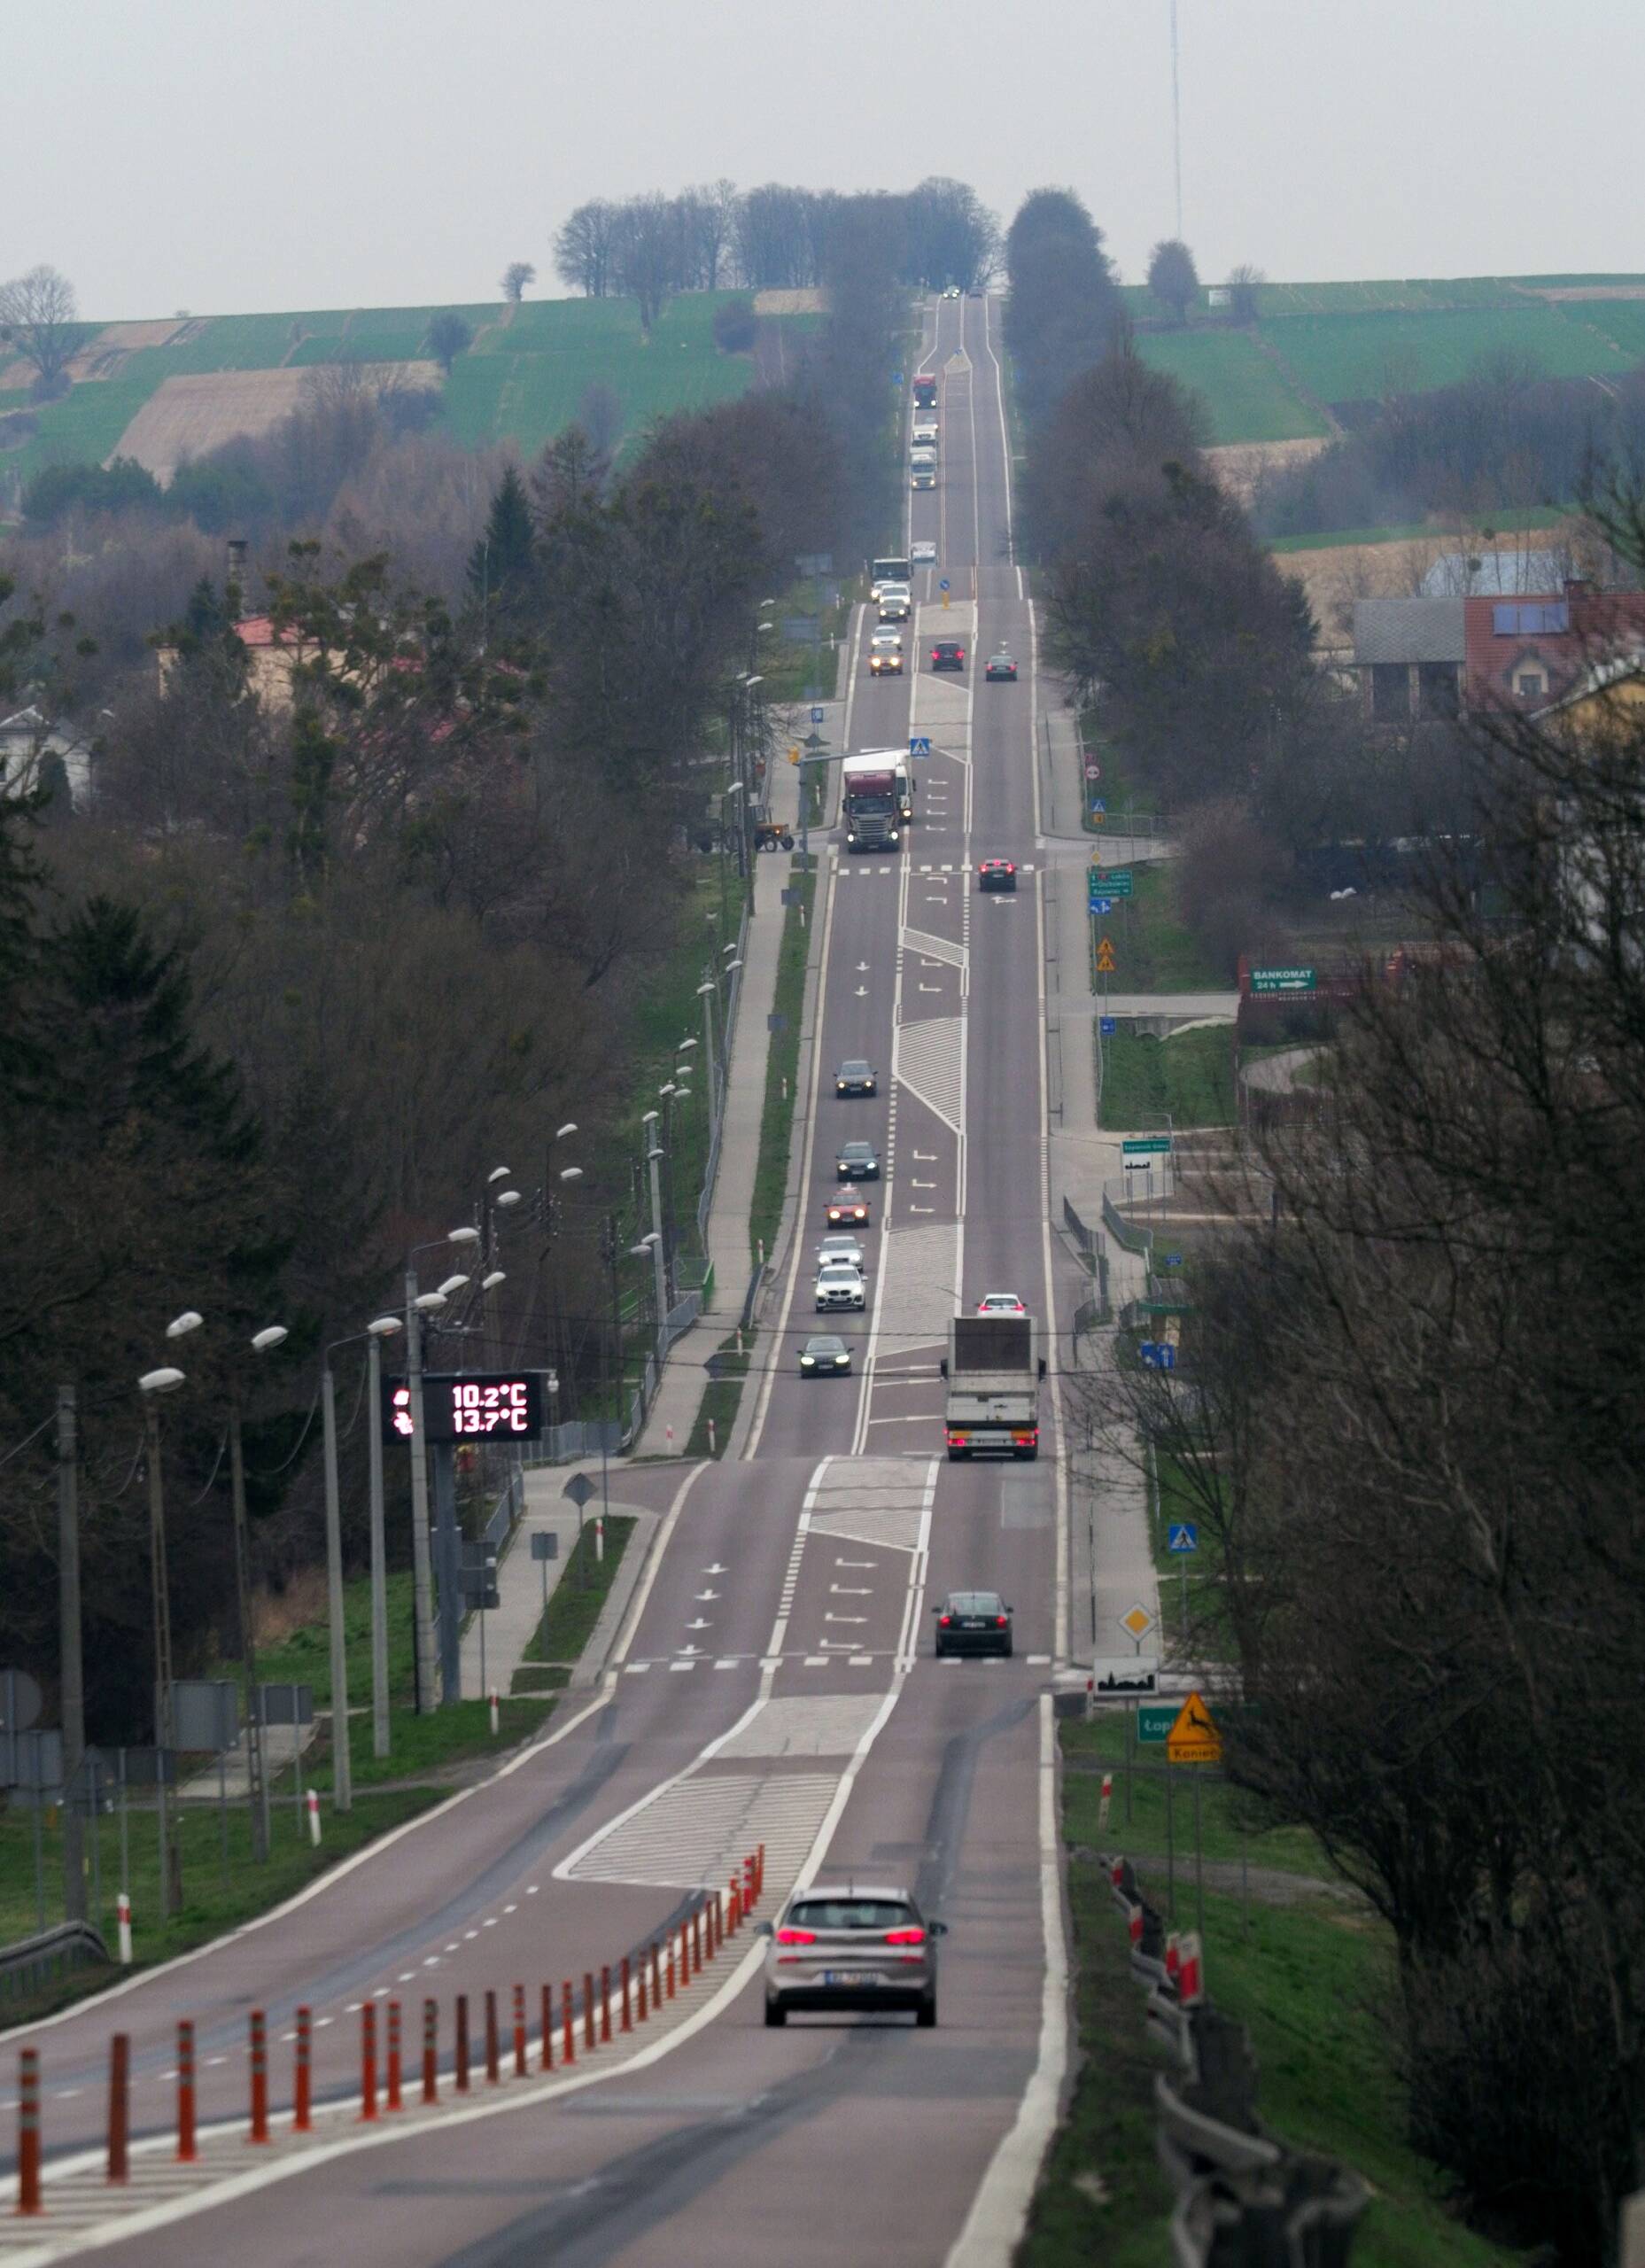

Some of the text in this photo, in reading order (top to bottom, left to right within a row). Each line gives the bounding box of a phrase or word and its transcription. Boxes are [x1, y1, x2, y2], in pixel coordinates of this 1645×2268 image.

[1254, 970, 1311, 979] BANKOMAT
[452, 1383, 527, 1408] 10.2°C
[453, 1408, 528, 1433] 13.7°C
